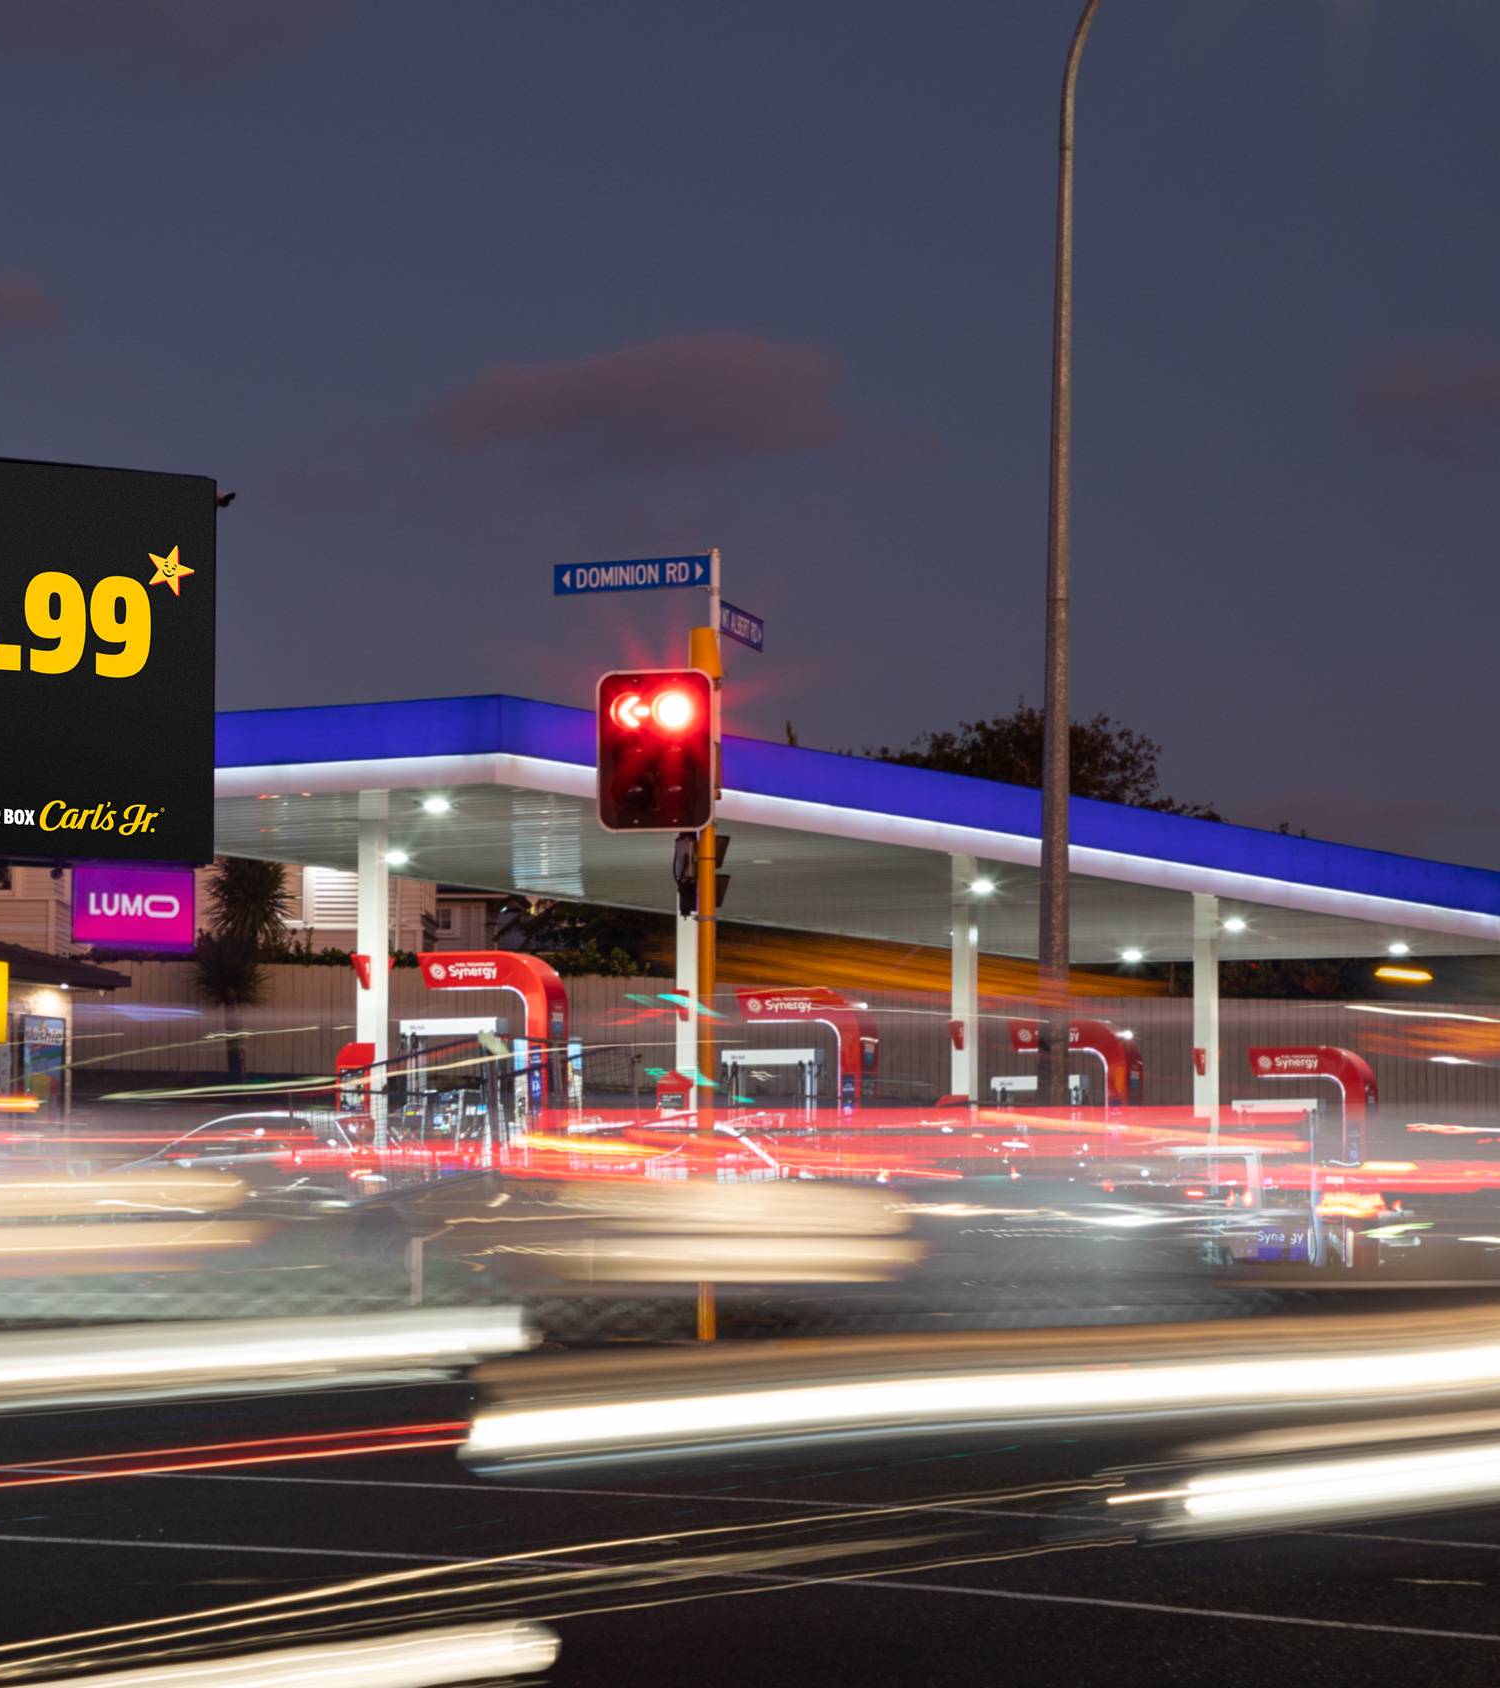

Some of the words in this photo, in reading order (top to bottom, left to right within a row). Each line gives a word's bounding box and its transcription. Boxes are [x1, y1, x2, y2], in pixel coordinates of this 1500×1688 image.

[575, 563, 660, 588] DOMINION
[666, 561, 690, 583] RD
[3, 807, 36, 826] BOX
[39, 800, 116, 832] Carl's
[119, 804, 160, 836] Jr.
[88, 892, 180, 918] LUMO
[447, 964, 497, 980] Synergy
[764, 999, 812, 1013] Synergy
[1274, 1056, 1319, 1069] Synergy
[1257, 1231, 1304, 1245] Synegy
